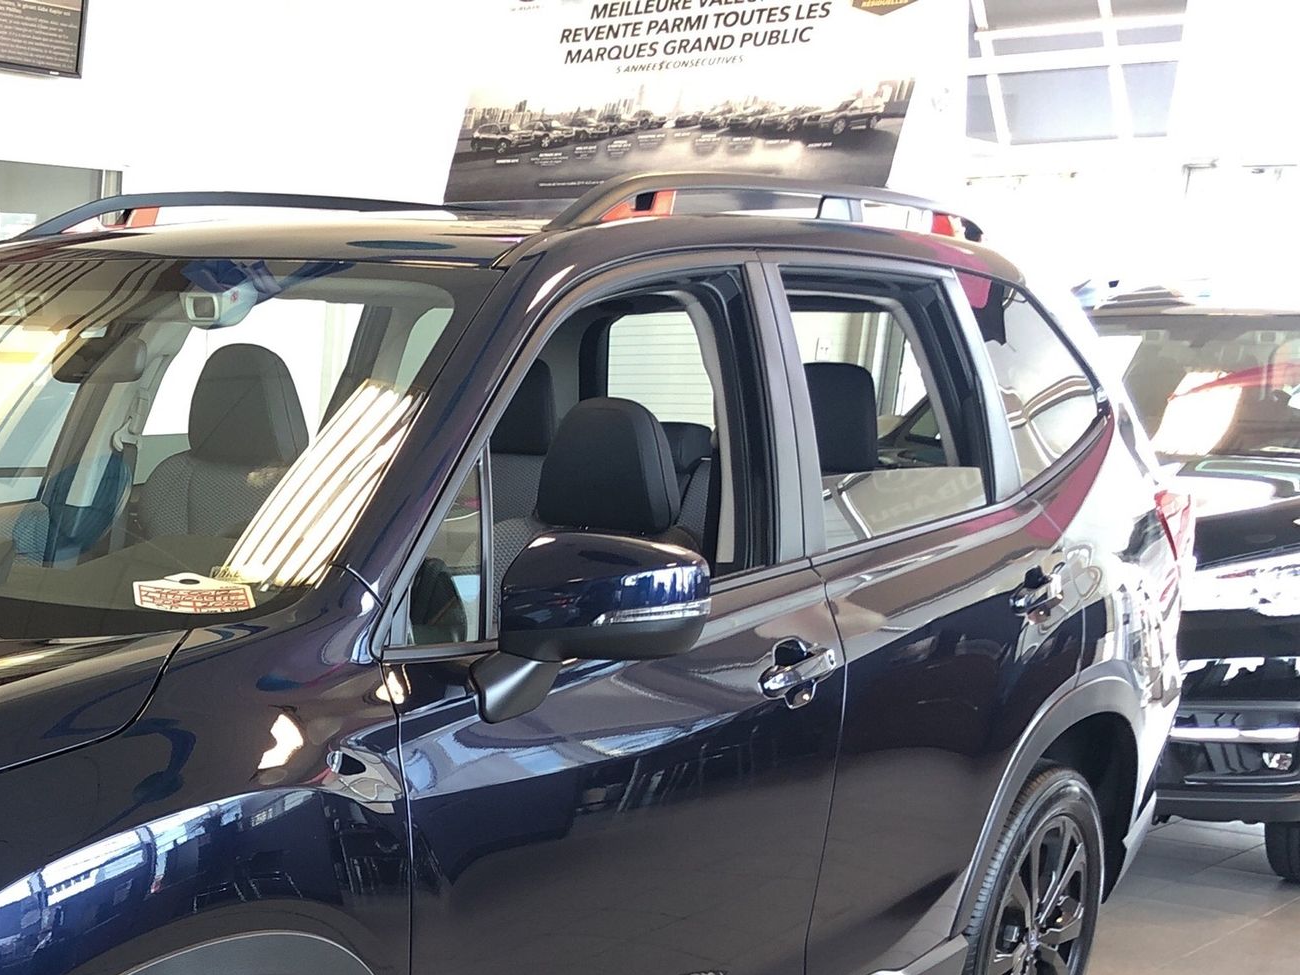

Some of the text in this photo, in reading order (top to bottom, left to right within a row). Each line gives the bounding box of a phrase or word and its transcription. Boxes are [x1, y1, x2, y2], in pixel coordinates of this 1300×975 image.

[560, 1, 832, 44] REVENTE PARMI TOUTES LES
[591, 0, 692, 20] MEILLEURE
[564, 26, 814, 64] MARQUES GRAND PUBLIC
